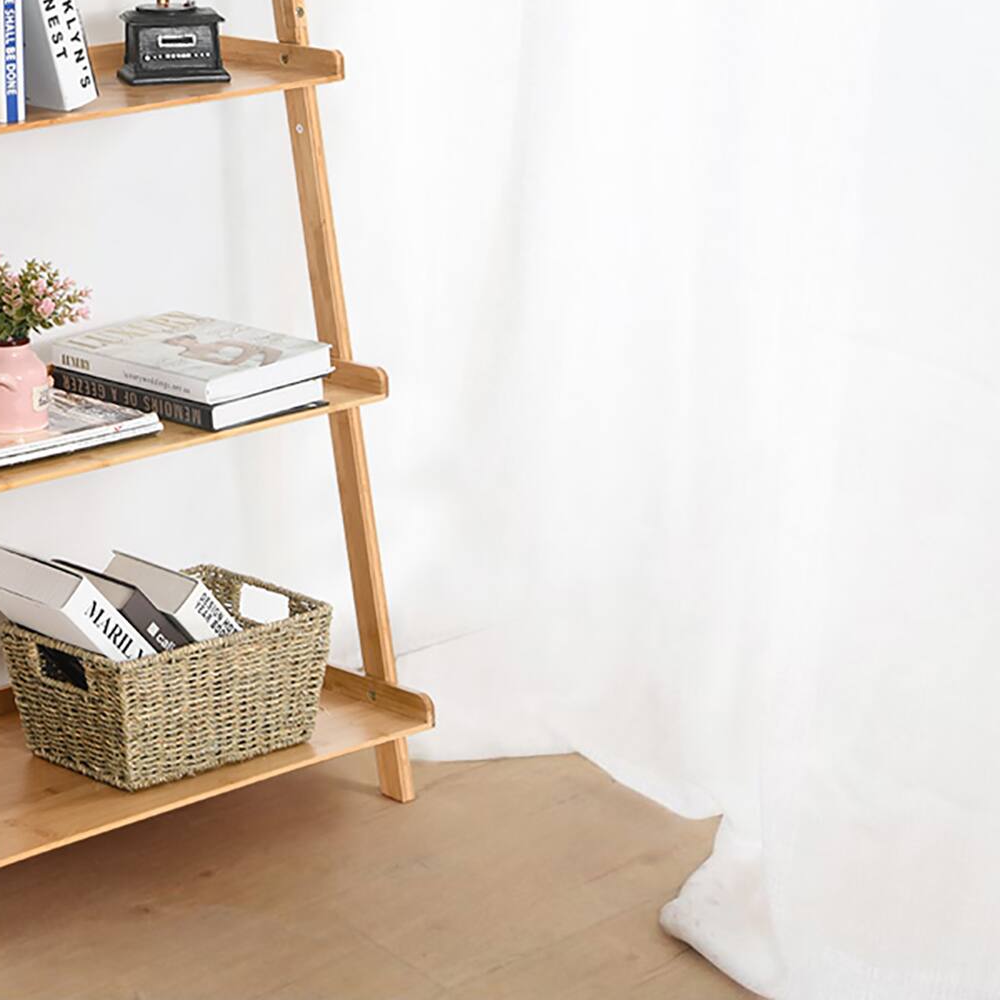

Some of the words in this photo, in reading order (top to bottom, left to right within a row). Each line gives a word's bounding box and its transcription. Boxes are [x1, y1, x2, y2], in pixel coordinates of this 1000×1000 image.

[4, 8, 17, 45] SHALL
[5, 47, 17, 62] BE
[6, 63, 19, 96] DONE
[62, 374, 106, 399] GEEZER
[110, 387, 120, 402] A
[123, 391, 138, 407] OF
[143, 396, 202, 425] MEMOIRS
[84, 600, 144, 659] MARIL
[210, 619, 226, 638] BOO
